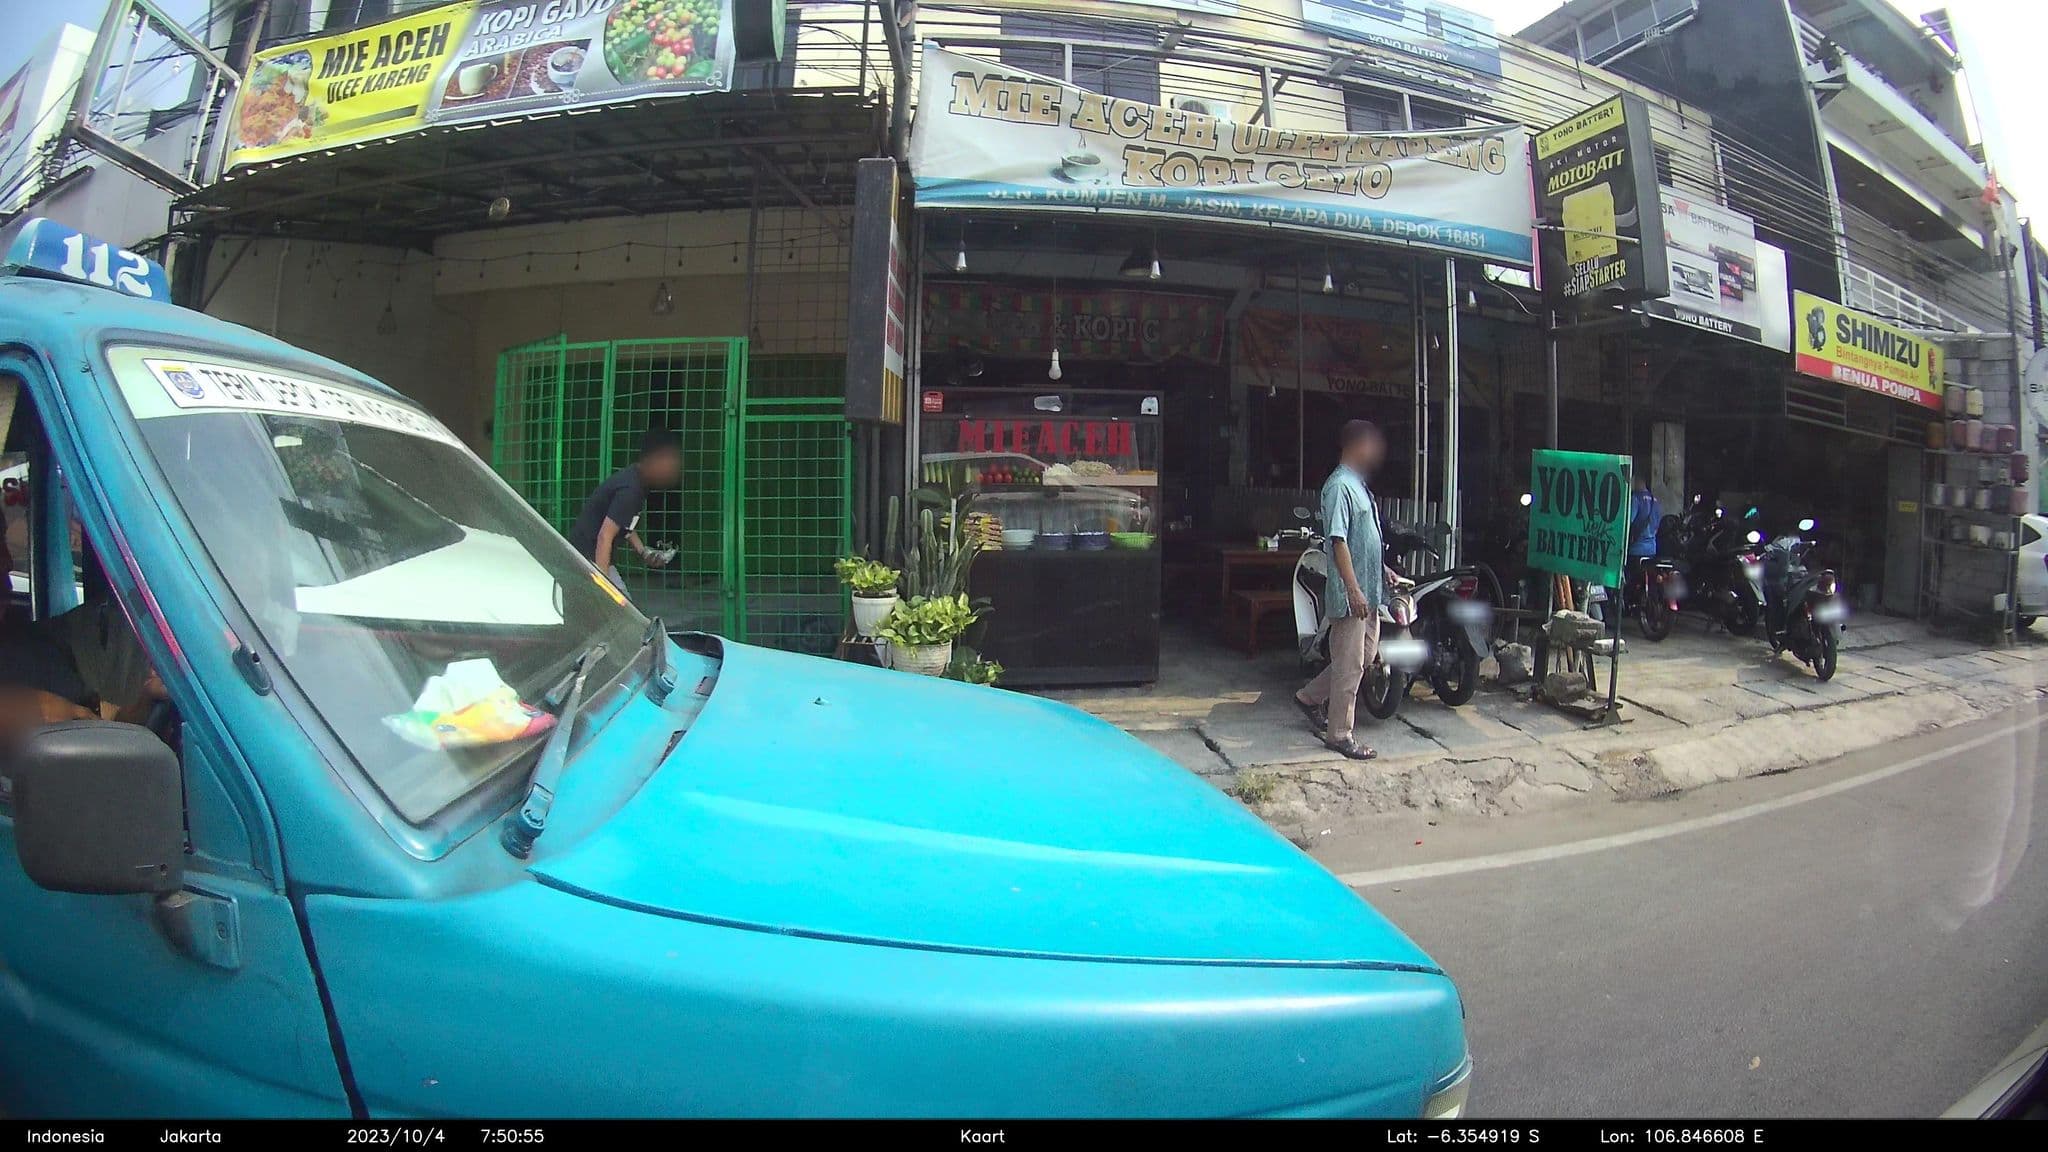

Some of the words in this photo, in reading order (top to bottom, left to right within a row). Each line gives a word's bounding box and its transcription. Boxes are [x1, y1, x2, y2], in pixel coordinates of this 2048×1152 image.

[473, 4, 538, 37] KOPI
[317, 40, 369, 79] MIE
[370, 23, 451, 69] ACEH
[464, 25, 562, 57] ARABICA
[1368, 34, 1402, 49] YONO
[1404, 43, 1449, 61] BATTERY
[327, 77, 363, 104] ULEE
[361, 63, 431, 95] KARENG
[949, 71, 1062, 126] MIE
[1070, 90, 1220, 151] ACEH
[1552, 125, 1574, 142] YONO
[1576, 106, 1616, 132] BATTERY
[1122, 144, 1260, 188] KOPI
[1577, 135, 1618, 159] MOTOR
[1547, 148, 1625, 196] MOTOBATT
[1178, 195, 1242, 217] JASIN,
[1252, 203, 1329, 226] KELAPA
[1333, 211, 1376, 234] DUA,
[1382, 218, 1440, 240] DEPOK
[1446, 229, 1486, 249] 16451
[1690, 213, 1731, 236] BATTERY
[61, 233, 153, 298] 112
[1563, 259, 1627, 298] #SIAPSTARTER
[1575, 255, 1600, 278] SELALU
[1074, 313, 1137, 343] KOPI
[1673, 308, 1697, 324] YONO
[1698, 315, 1733, 334] BATTERY
[1836, 313, 1920, 368] SHIMIZU
[1832, 364, 1879, 391] BENUA
[1881, 379, 1921, 403] POMPA
[1537, 465, 1622, 524] YONO
[1536, 528, 1613, 567] BATTERY
